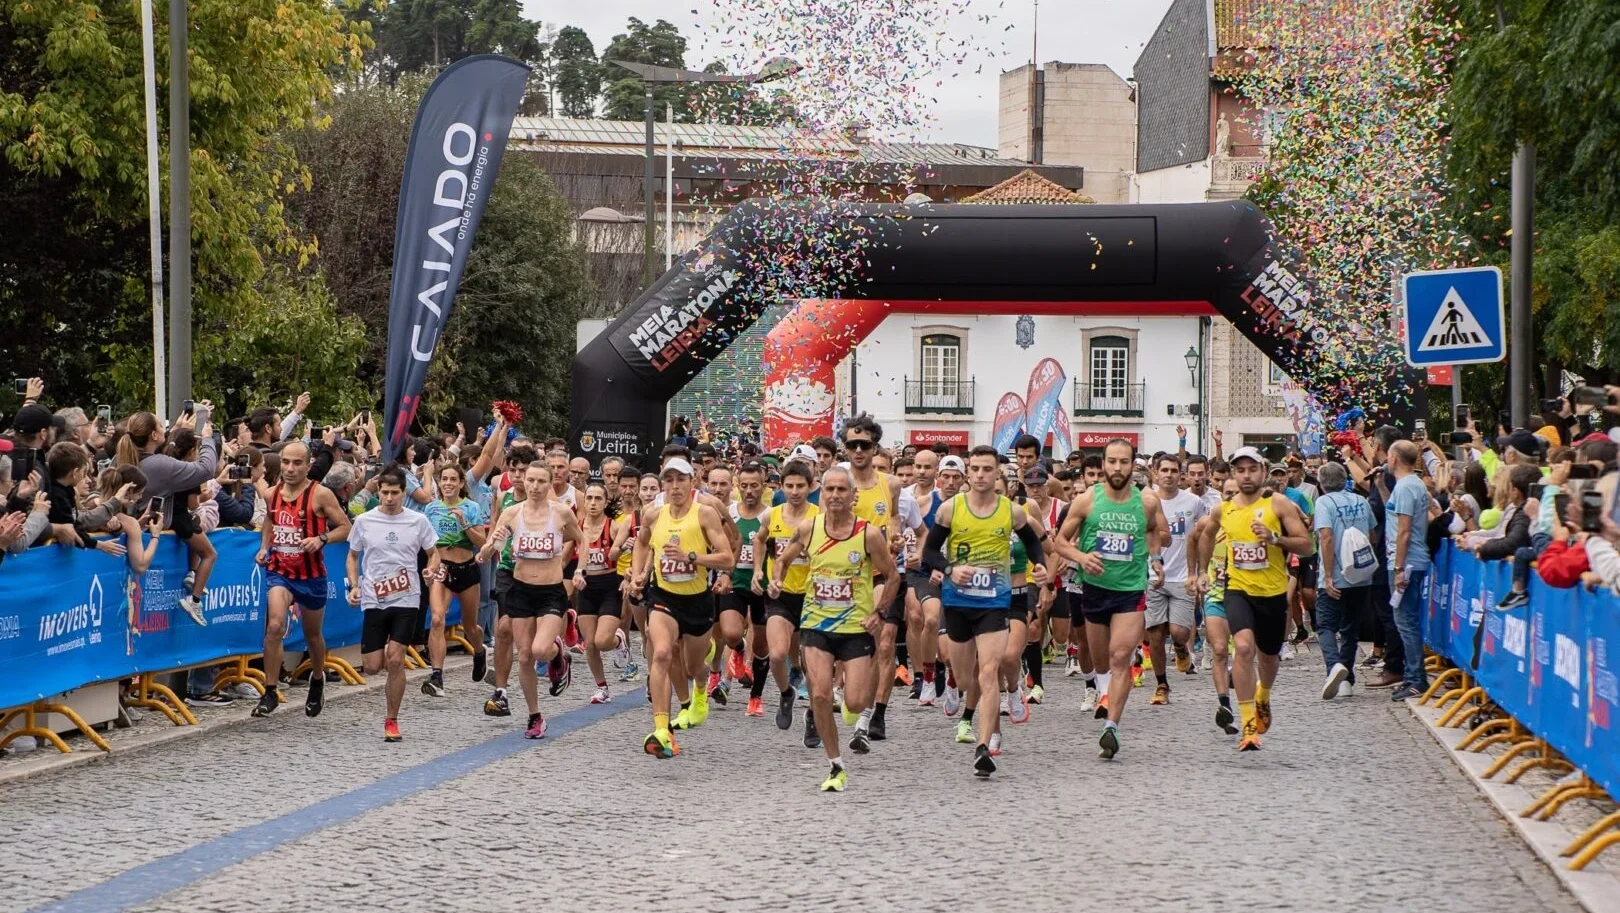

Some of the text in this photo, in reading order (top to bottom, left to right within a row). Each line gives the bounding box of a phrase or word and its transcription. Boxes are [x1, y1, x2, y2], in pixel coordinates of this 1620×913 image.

[458, 210, 472, 240] onde
[465, 192, 476, 208] há
[1264, 260, 1311, 307] MEIA
[639, 270, 738, 360] MARATONA
[628, 305, 674, 347] MEIA
[925, 434, 963, 442] Santander
[597, 438, 638, 454] Leiria
[1336, 503, 1365, 518] STAFF
[1098, 521, 1140, 532] SANTOS
[273, 531, 301, 545] 2845
[520, 536, 551, 550] 3068
[1101, 537, 1128, 552] 280
[1234, 547, 1266, 561] 2630
[376, 575, 408, 595] 2119
[816, 583, 851, 598] 2584
